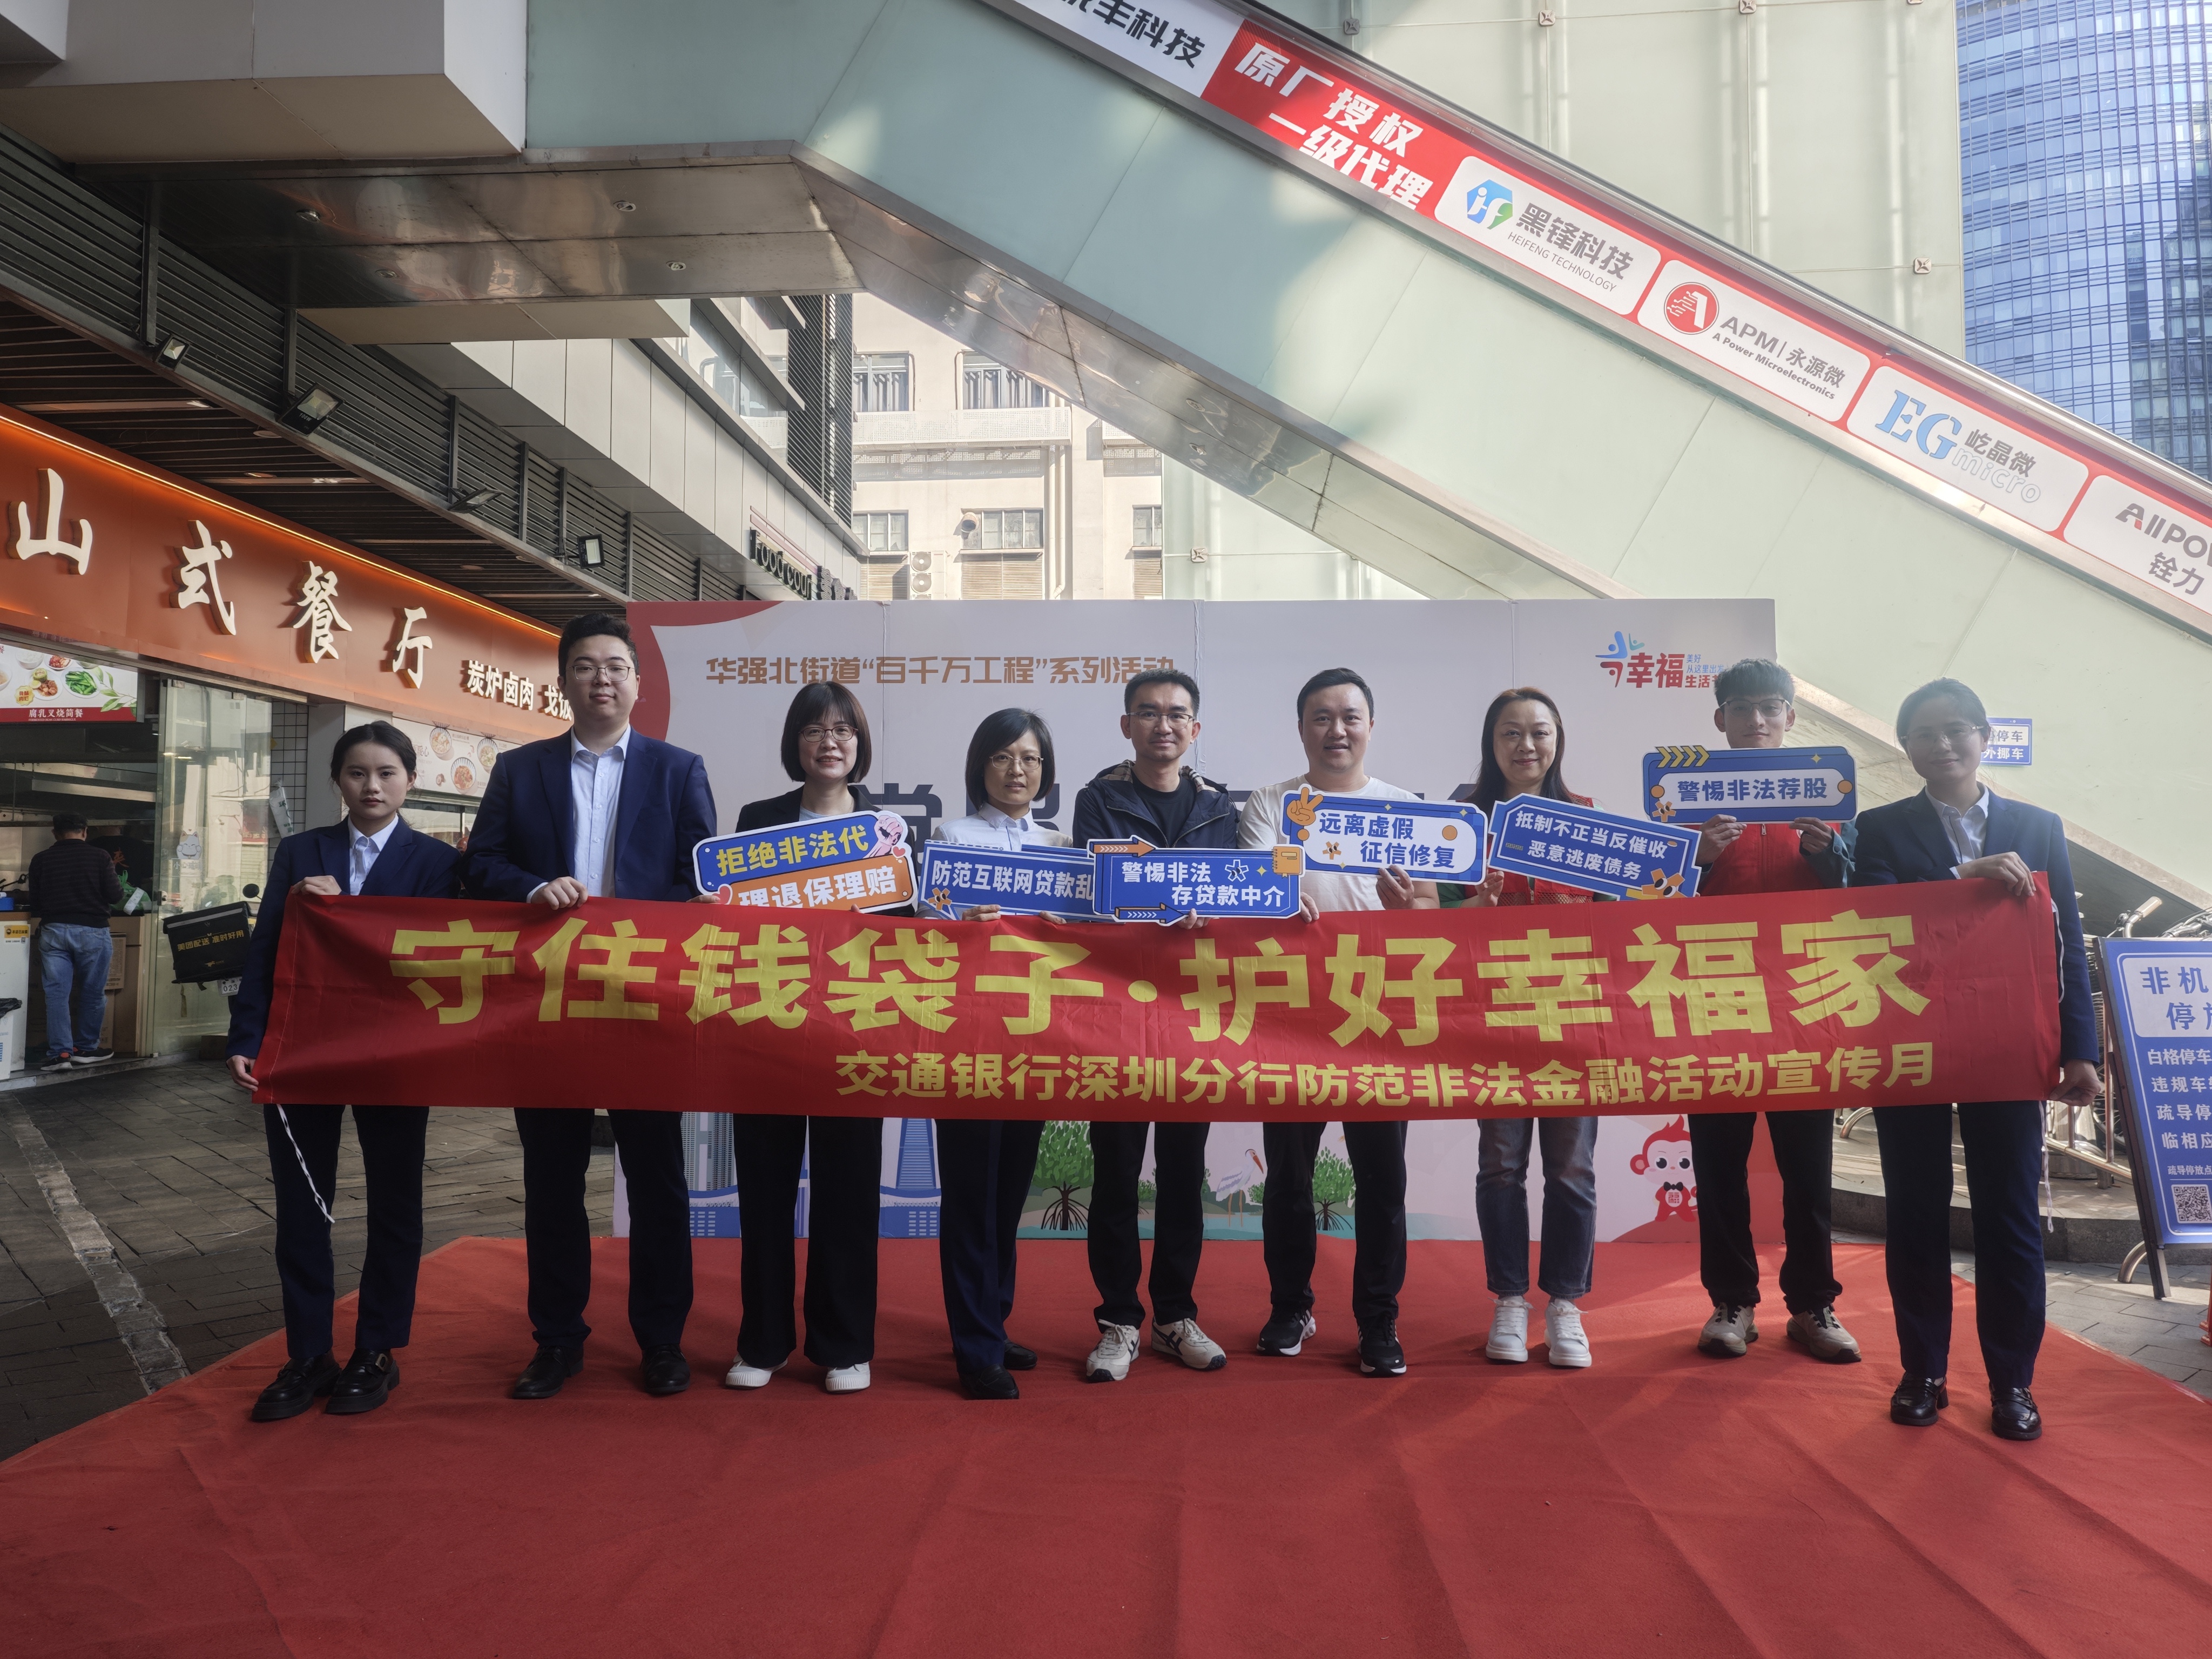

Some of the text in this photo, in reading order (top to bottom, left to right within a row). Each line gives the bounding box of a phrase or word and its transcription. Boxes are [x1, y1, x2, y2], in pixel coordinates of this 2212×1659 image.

[1061, 0, 1205, 69] 丰科技
[1235, 42, 1424, 158] 原厂授权
[1269, 112, 1434, 210] 一级代理
[1507, 231, 1617, 293] HEIFENG TECHNOLOGY
[1515, 203, 1634, 280] 黑锋科技
[1712, 333, 1836, 400] A Power Microelectronics
[1719, 316, 1846, 388] APM 永源微
[1874, 389, 1963, 460] EG
[1964, 429, 2036, 477] 屹晶微
[1952, 448, 2041, 503] micro
[8, 468, 433, 689] 山式餐厅
[2148, 551, 2205, 595] 铨力
[1626, 652, 1685, 689] 幸福
[1686, 653, 1701, 664] 美好
[1686, 664, 1724, 674] 从这里出发
[466, 659, 534, 711] 炭炉卤肉
[1983, 746, 2024, 760] 外挪车
[1989, 729, 2024, 743] 停车
[1677, 778, 1827, 802] 警惕非法荐股
[1319, 812, 1414, 840] 远离虚假
[1515, 810, 1668, 859] 抵制不正当反催收
[716, 824, 869, 877] 拒绝非法代
[1360, 840, 1455, 868] 征信修复
[1527, 839, 1642, 880] 恶意逃废债务
[738, 865, 897, 908] 理退保理赔
[1121, 861, 1211, 884] 警惕非法
[1171, 884, 1285, 907] 存贷款中介
[177, 937, 210, 952] 美团配送
[2140, 966, 2209, 995] 非机
[835, 1041, 1934, 1107] 交通银行深圳分行防范非法金融活动宣传月
[2147, 1048, 2212, 1065] 白格停车
[2151, 1076, 2212, 1093] 违规车
[2155, 1103, 2212, 1121] 疏导停
[2167, 1165, 2212, 1176] 疏导停放点
